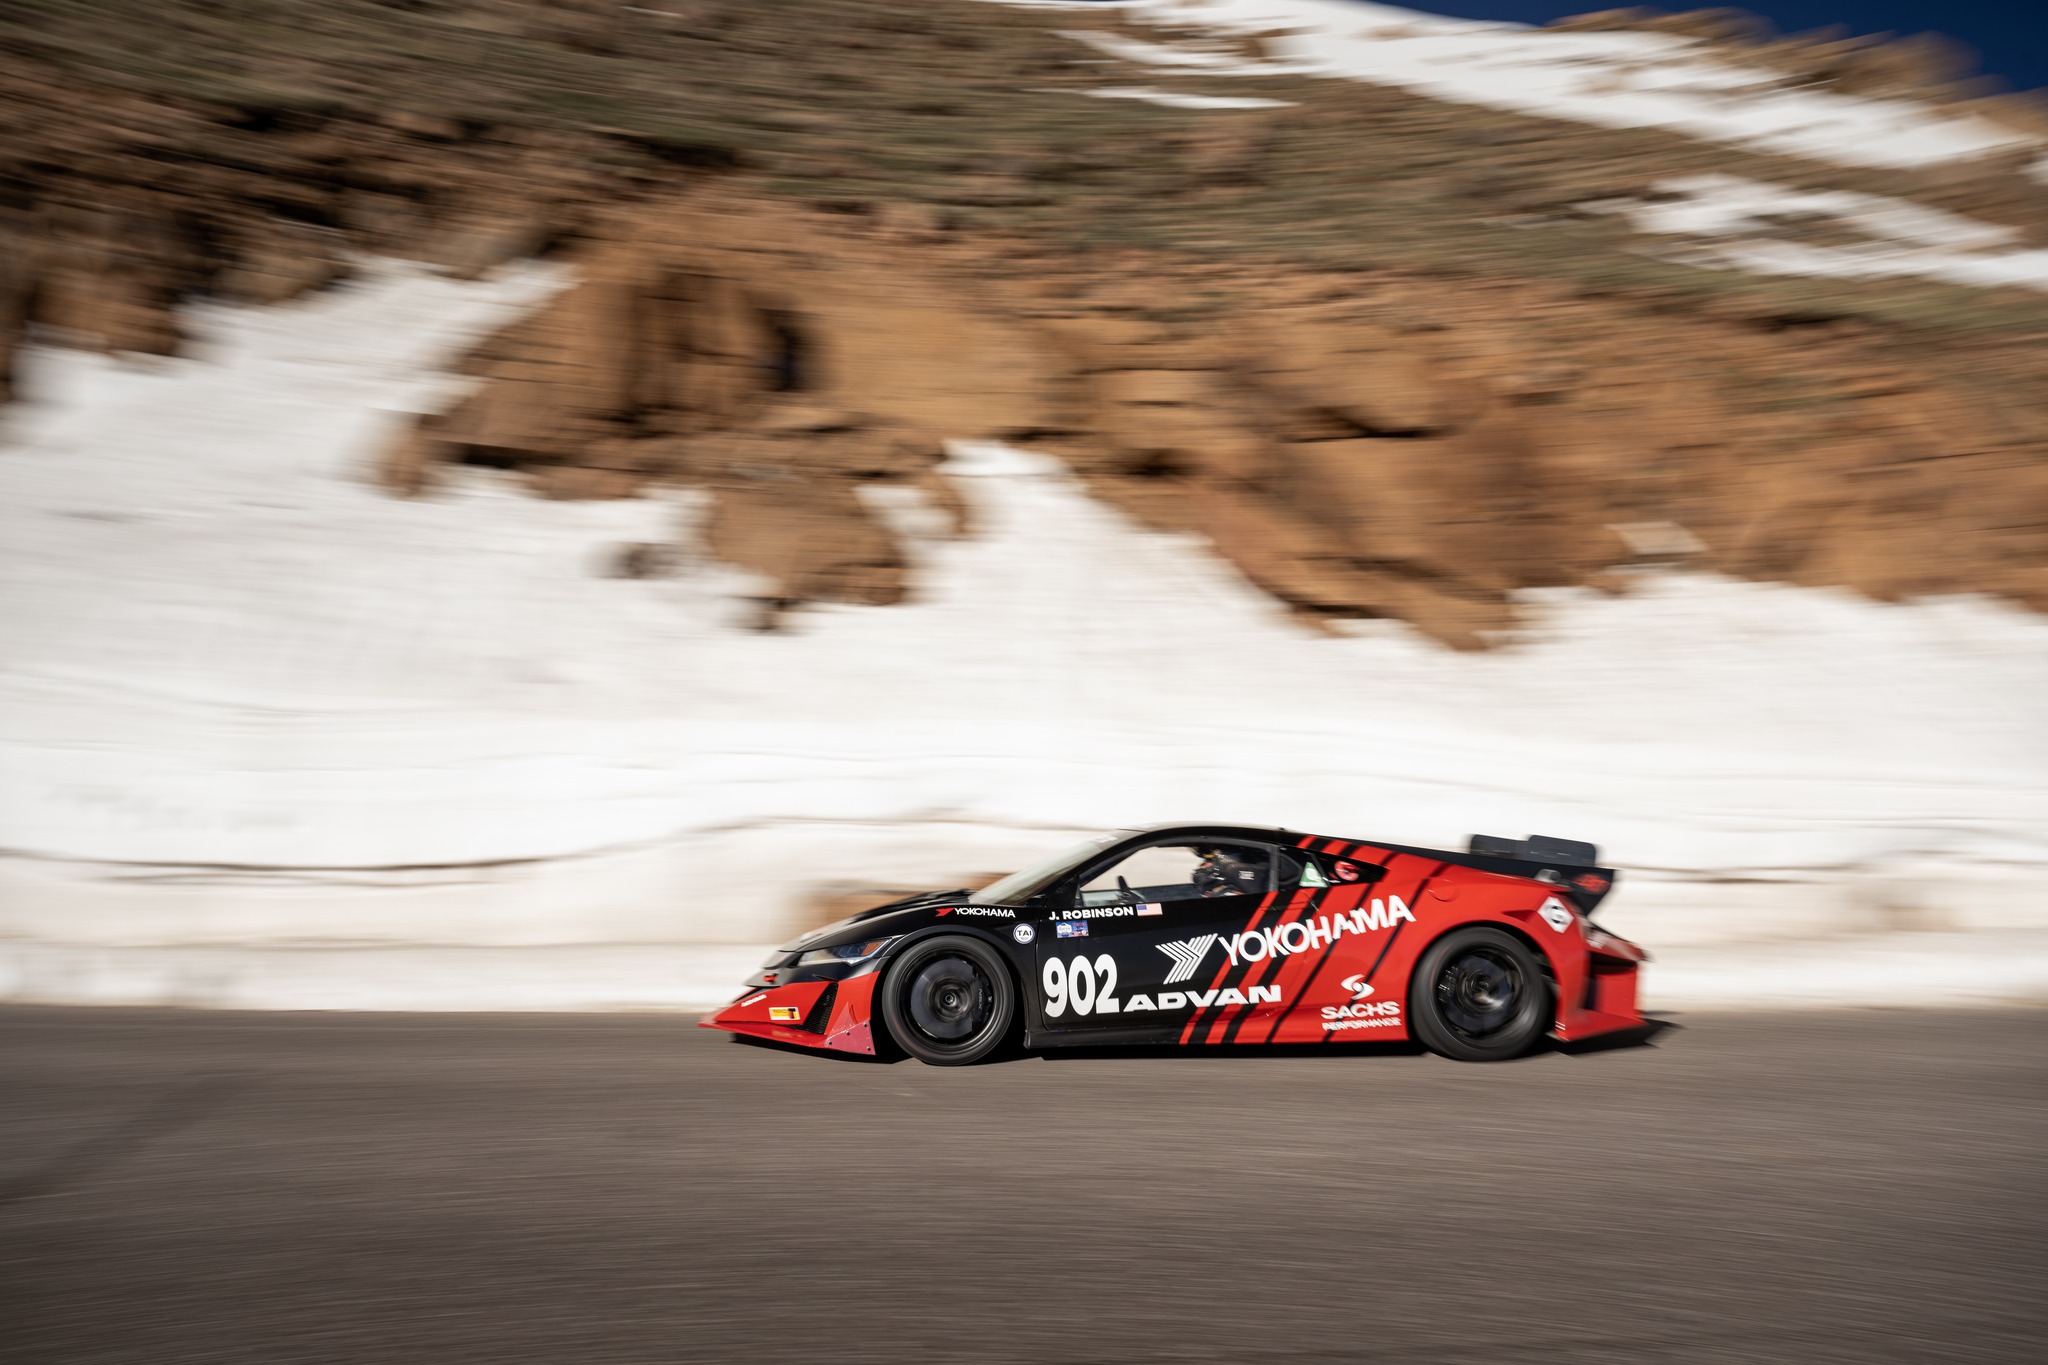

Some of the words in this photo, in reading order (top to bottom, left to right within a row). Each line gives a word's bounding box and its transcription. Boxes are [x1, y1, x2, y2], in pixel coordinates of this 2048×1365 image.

[954, 907, 1016, 918] YOKOHAMA
[1048, 911, 1060, 921] J.
[1062, 906, 1134, 920] ROBINSON
[1217, 895, 1417, 966] YOKOHAMA
[1043, 953, 1119, 1018] 902
[1123, 984, 1282, 1013] ADVAN
[1320, 1001, 1402, 1020] SACHS
